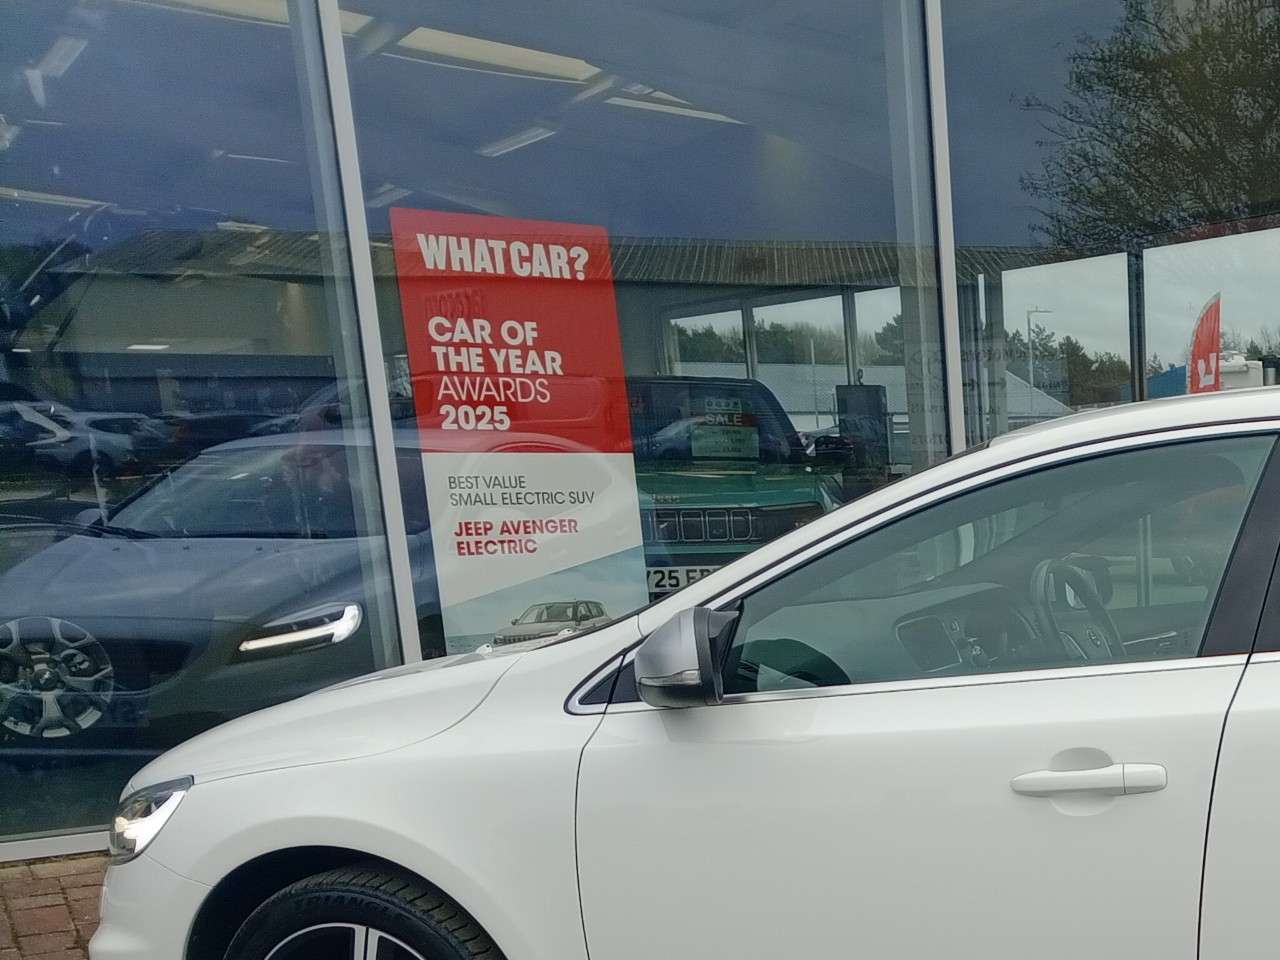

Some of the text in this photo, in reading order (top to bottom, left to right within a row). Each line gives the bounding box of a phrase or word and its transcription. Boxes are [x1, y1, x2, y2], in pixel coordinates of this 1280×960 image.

[416, 233, 589, 281] WHAT CAR?
[427, 316, 538, 346] CAR OF
[431, 346, 564, 375] THE YEAR
[437, 375, 551, 403] AWARDS
[439, 404, 511, 430] 2025
[705, 413, 743, 425] SALE
[448, 475, 527, 490] BEST VALUE
[450, 491, 595, 507] SMALL ELECTRIC SUV
[454, 519, 579, 537] JEEP AVENGER
[456, 538, 538, 556] ELECTRIC
